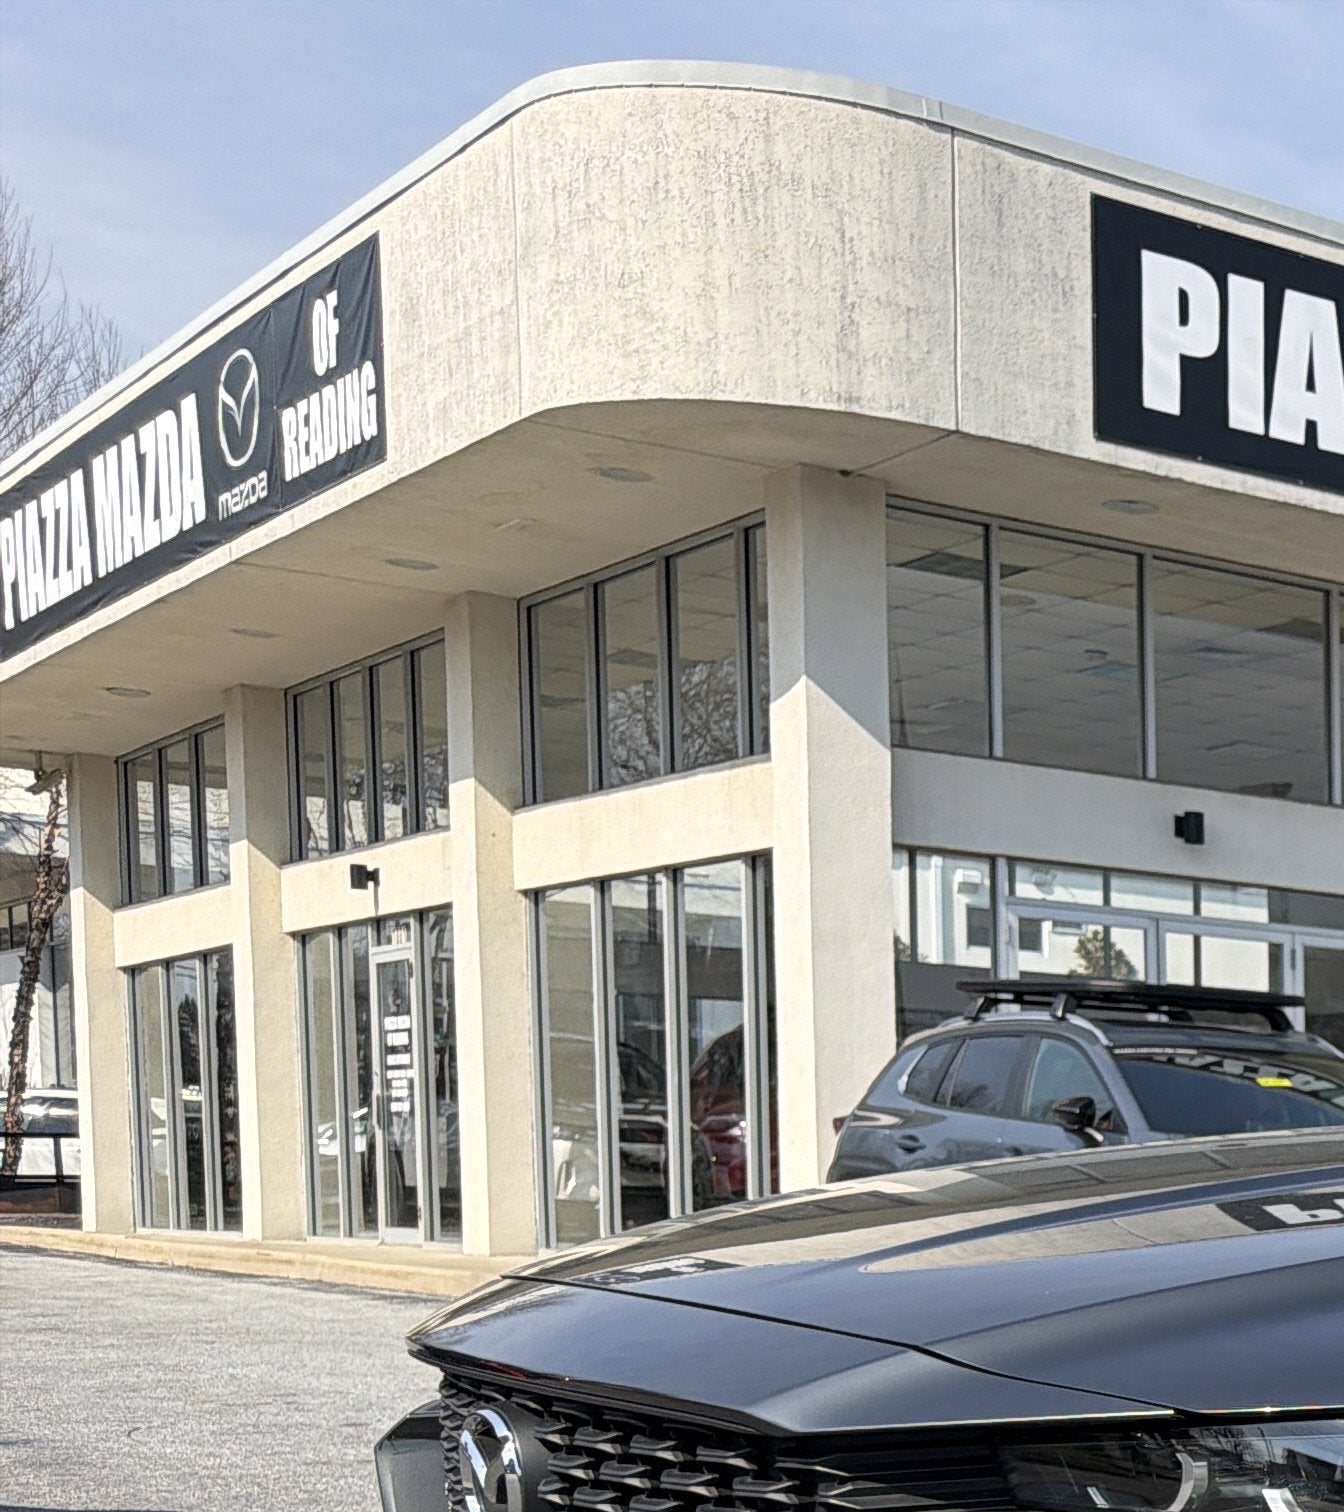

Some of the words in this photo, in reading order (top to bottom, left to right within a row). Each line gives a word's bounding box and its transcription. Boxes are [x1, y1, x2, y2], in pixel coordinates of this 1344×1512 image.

[312, 290, 339, 376] OF
[281, 361, 378, 481] READING
[0, 468, 93, 630] PIAZZA
[92, 393, 206, 578] MAZDA
